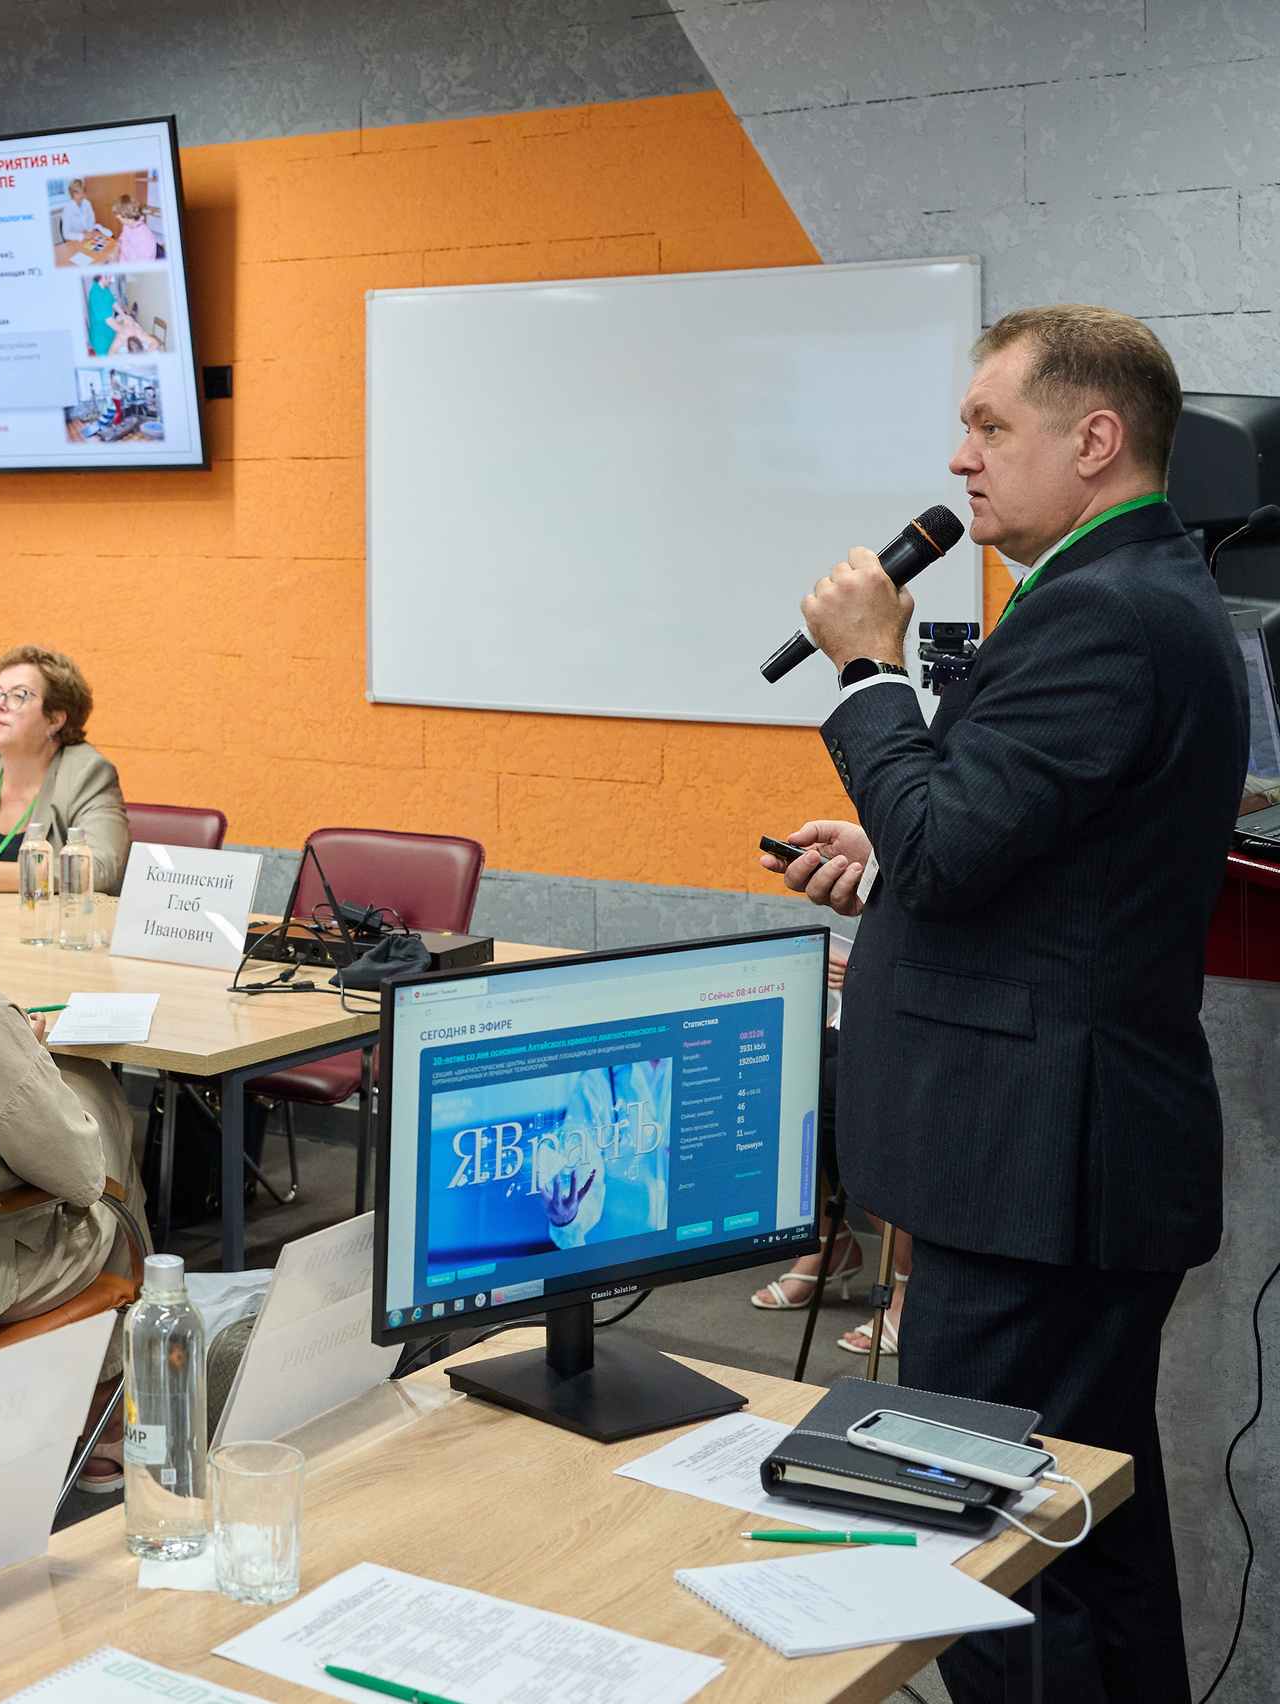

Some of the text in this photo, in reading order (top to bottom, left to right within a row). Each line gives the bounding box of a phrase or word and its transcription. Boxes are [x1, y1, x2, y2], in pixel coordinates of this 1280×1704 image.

[52, 153, 70, 166] НА
[147, 865, 234, 890] Колпинский
[167, 894, 201, 912] Глеб
[144, 920, 214, 943] Иванович
[708, 982, 785, 1001] Сейчас 08:44 GMT +3
[420, 1018, 513, 1041] СЕГОДНЯ В ЭФИРЕ
[683, 1018, 719, 1029] Статистика
[433, 1055, 466, 1066] 30-летие
[466, 1053, 476, 1061] со
[490, 1045, 527, 1058] основания
[528, 1039, 567, 1053] Алтайского
[567, 1035, 598, 1047] краевого
[599, 1027, 657, 1042] диагностического
[739, 1045, 753, 1053] 3931
[738, 1054, 770, 1066] 1920x1080
[738, 1071, 742, 1079] 1
[738, 1088, 746, 1097] 46
[737, 1102, 746, 1111] 46
[736, 1115, 745, 1124] 85
[736, 1129, 743, 1138] 11
[736, 1140, 764, 1152] Премиум
[591, 1284, 638, 1300] Classic Solution
